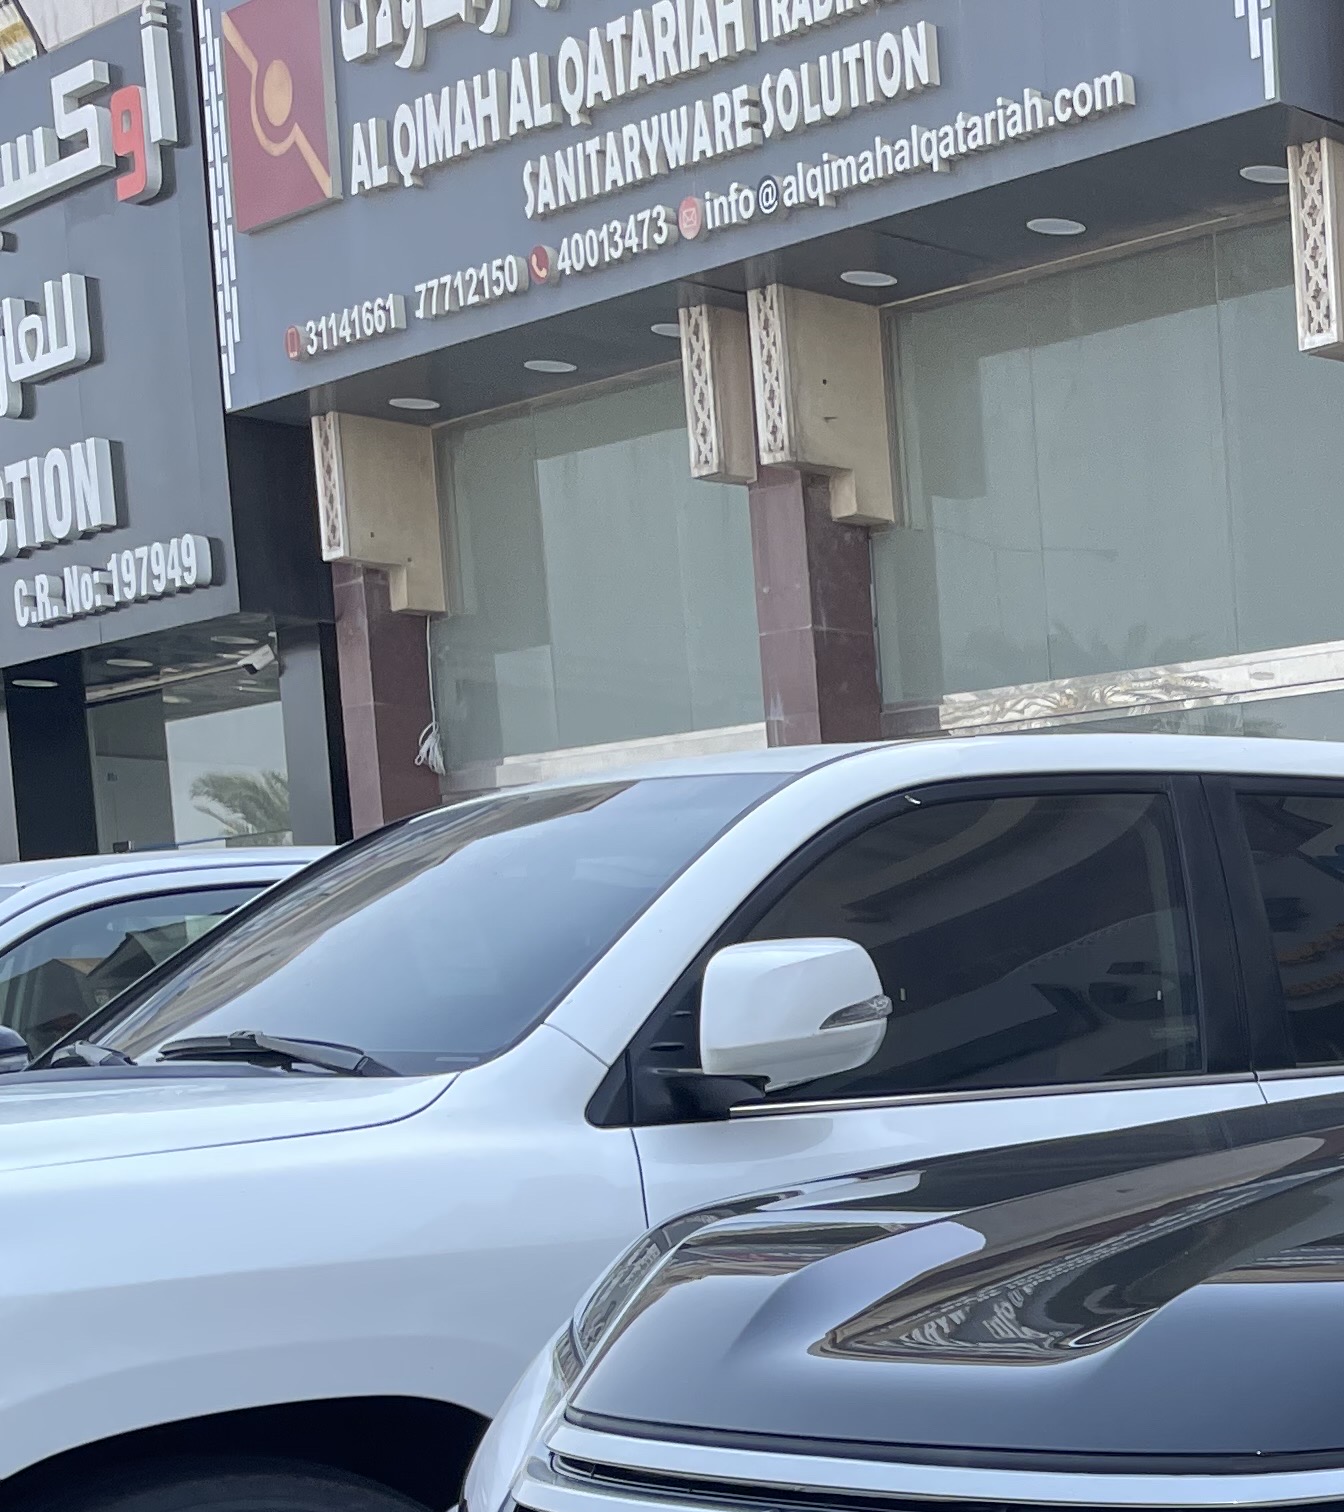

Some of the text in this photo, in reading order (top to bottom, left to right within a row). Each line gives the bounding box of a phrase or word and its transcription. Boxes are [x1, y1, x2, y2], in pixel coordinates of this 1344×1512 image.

[351, 117, 391, 196] AL
[393, 67, 502, 188] QIMAH
[508, 51, 554, 137] AL
[557, 0, 750, 127] QATARIAH
[523, 20, 932, 219] SANITARYWARE SOLUTION
[305, 293, 401, 356] 31141661
[557, 203, 671, 276] 40013473
[14, 573, 60, 627] C.R.
[106, 533, 200, 602] 197949
